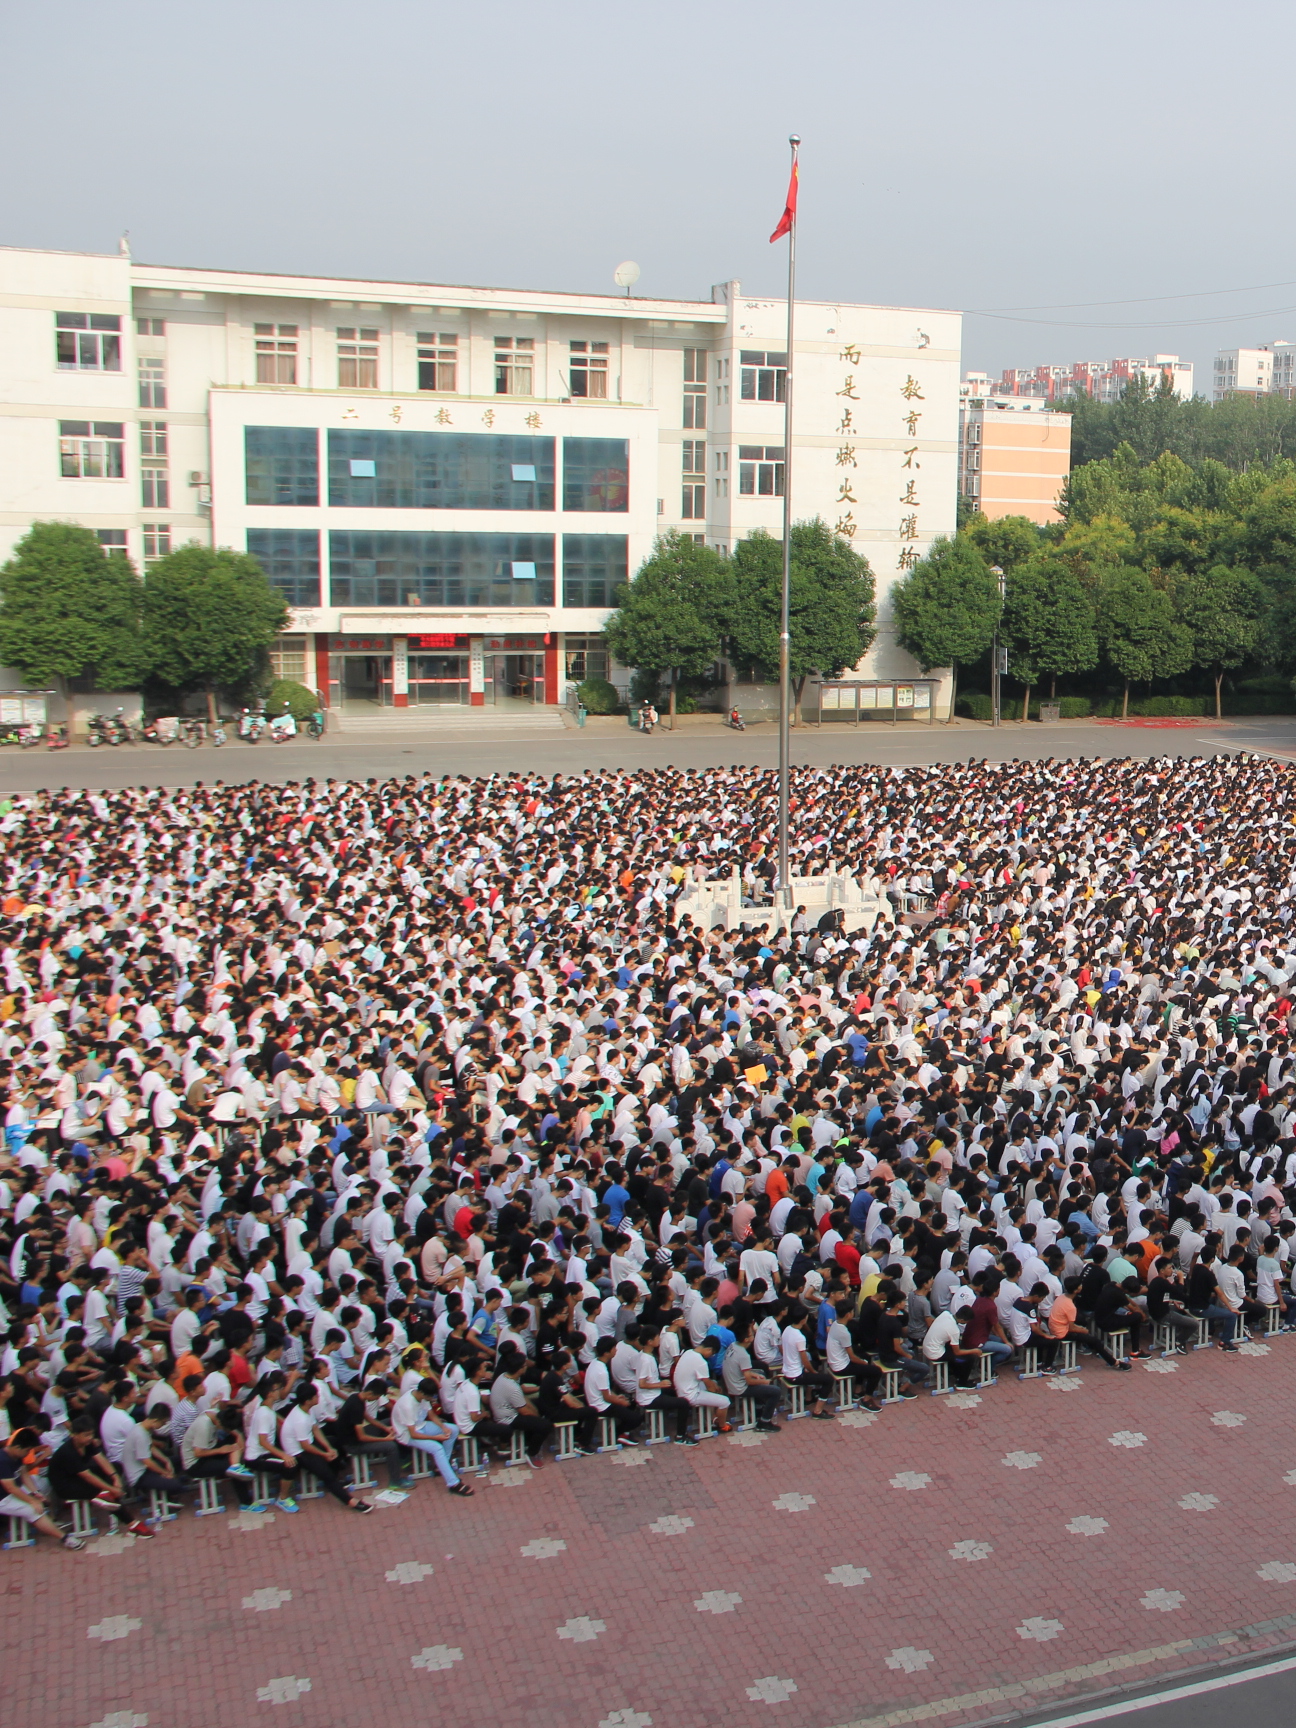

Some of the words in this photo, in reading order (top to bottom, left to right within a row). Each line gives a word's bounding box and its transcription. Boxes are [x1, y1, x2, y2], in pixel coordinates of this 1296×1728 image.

[342, 405, 543, 429] 二号教学楼
[835, 343, 861, 539] 而是点燃火焰
